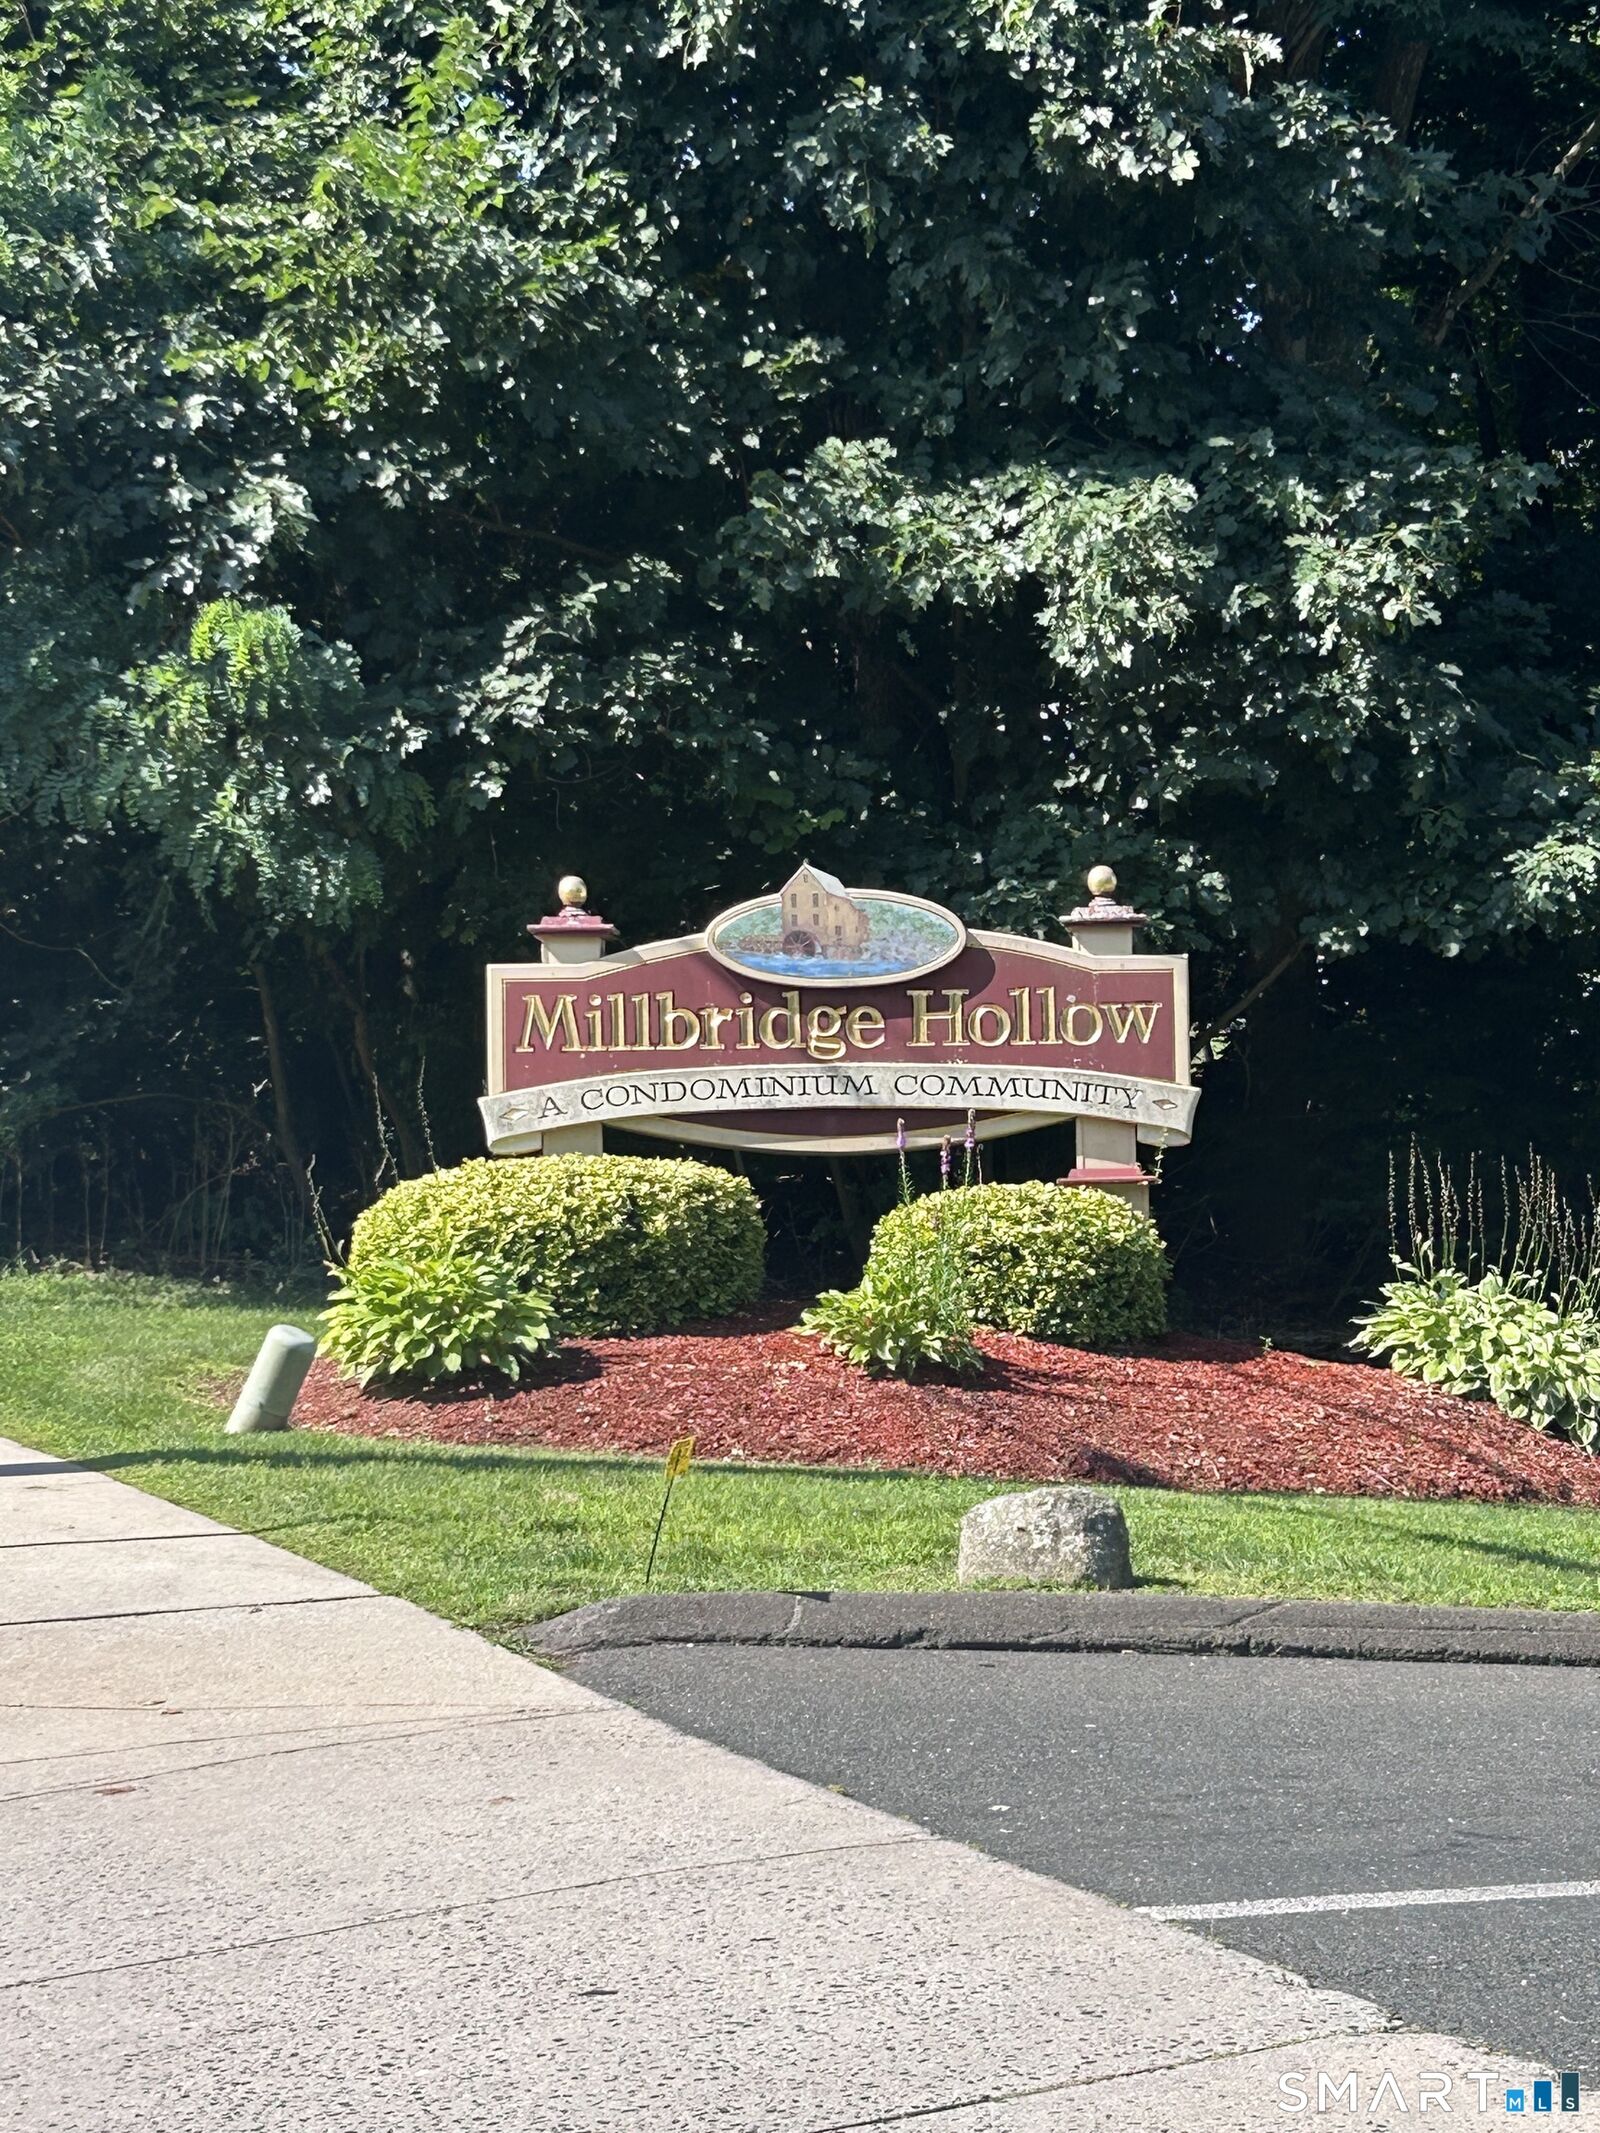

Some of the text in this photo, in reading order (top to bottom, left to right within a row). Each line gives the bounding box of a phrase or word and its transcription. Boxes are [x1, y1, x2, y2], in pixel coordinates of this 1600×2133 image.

[515, 986, 1162, 1060] Millbridge Hollow
[537, 1074, 1144, 1119] A CONDOMINIUM COMMUNITY
